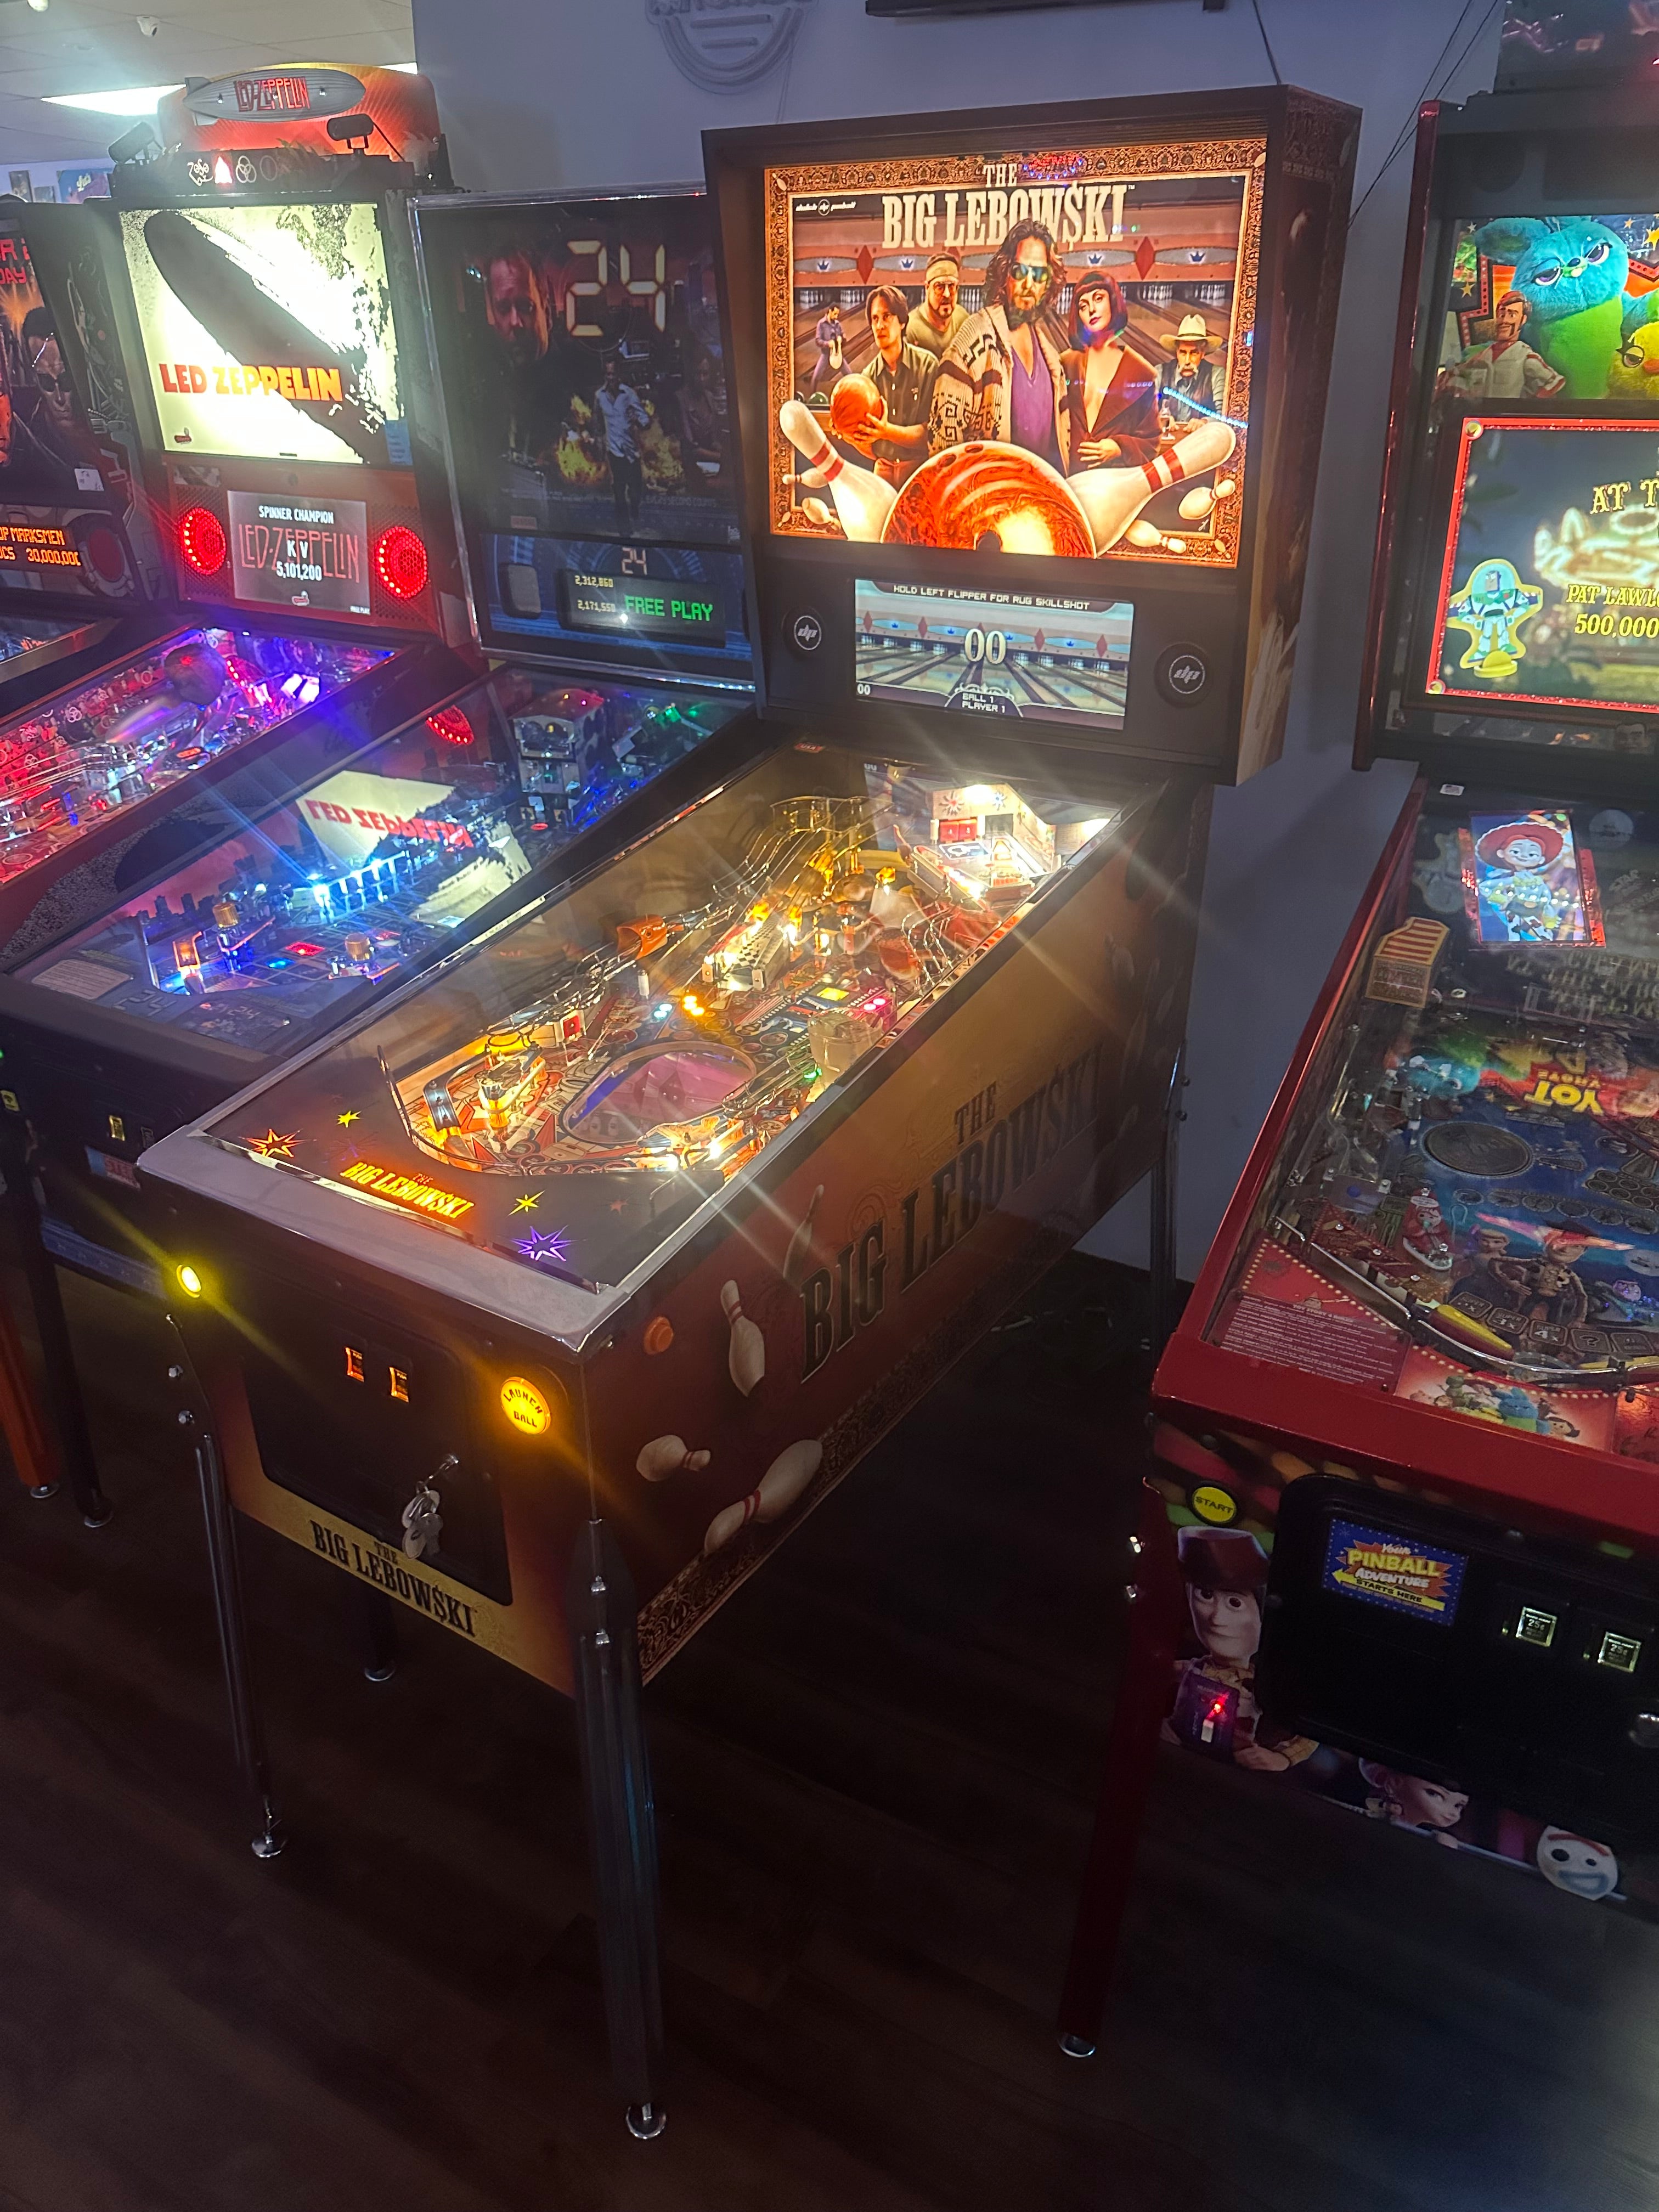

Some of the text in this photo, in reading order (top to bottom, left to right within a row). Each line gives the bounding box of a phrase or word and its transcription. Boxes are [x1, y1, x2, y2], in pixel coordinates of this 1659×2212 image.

[983, 163, 1017, 188] THE
[882, 194, 936, 249] BIG
[566, 240, 666, 336] 24
[159, 363, 343, 402] LED ZEPPELIN
[1589, 483, 1630, 515] AT
[259, 505, 334, 524] SPINNER CHAMPION
[10, 527, 65, 545] MARKSMEN
[276, 561, 323, 581] 5,101,200
[622, 548, 648, 575] 24
[893, 585, 1090, 610] HOLD LEFT FLIPPER FOR RUG SKILLSHOT
[1566, 584, 1601, 603] PAT
[624, 595, 713, 621] FREE PLAY
[964, 628, 1006, 664] 00
[857, 684, 871, 695] 00
[962, 693, 988, 703] BALL
[962, 701, 998, 713] PLAYER
[954, 1080, 997, 1146] THE
[340, 1162, 384, 1185] BIG
[413, 1173, 433, 1184] THE
[800, 1217, 888, 1384] BIG
[503, 1389, 543, 1414] LAUNCH
[514, 1410, 537, 1427] BALL
[1195, 1496, 1234, 1514] START
[310, 1519, 350, 1567] BIG
[374, 1541, 398, 1564] THE
[1347, 1550, 1440, 1576] PINBALL
[1355, 1568, 1430, 1588] ADVENTURE
[1356, 1579, 1423, 1603] STARTS HERE
